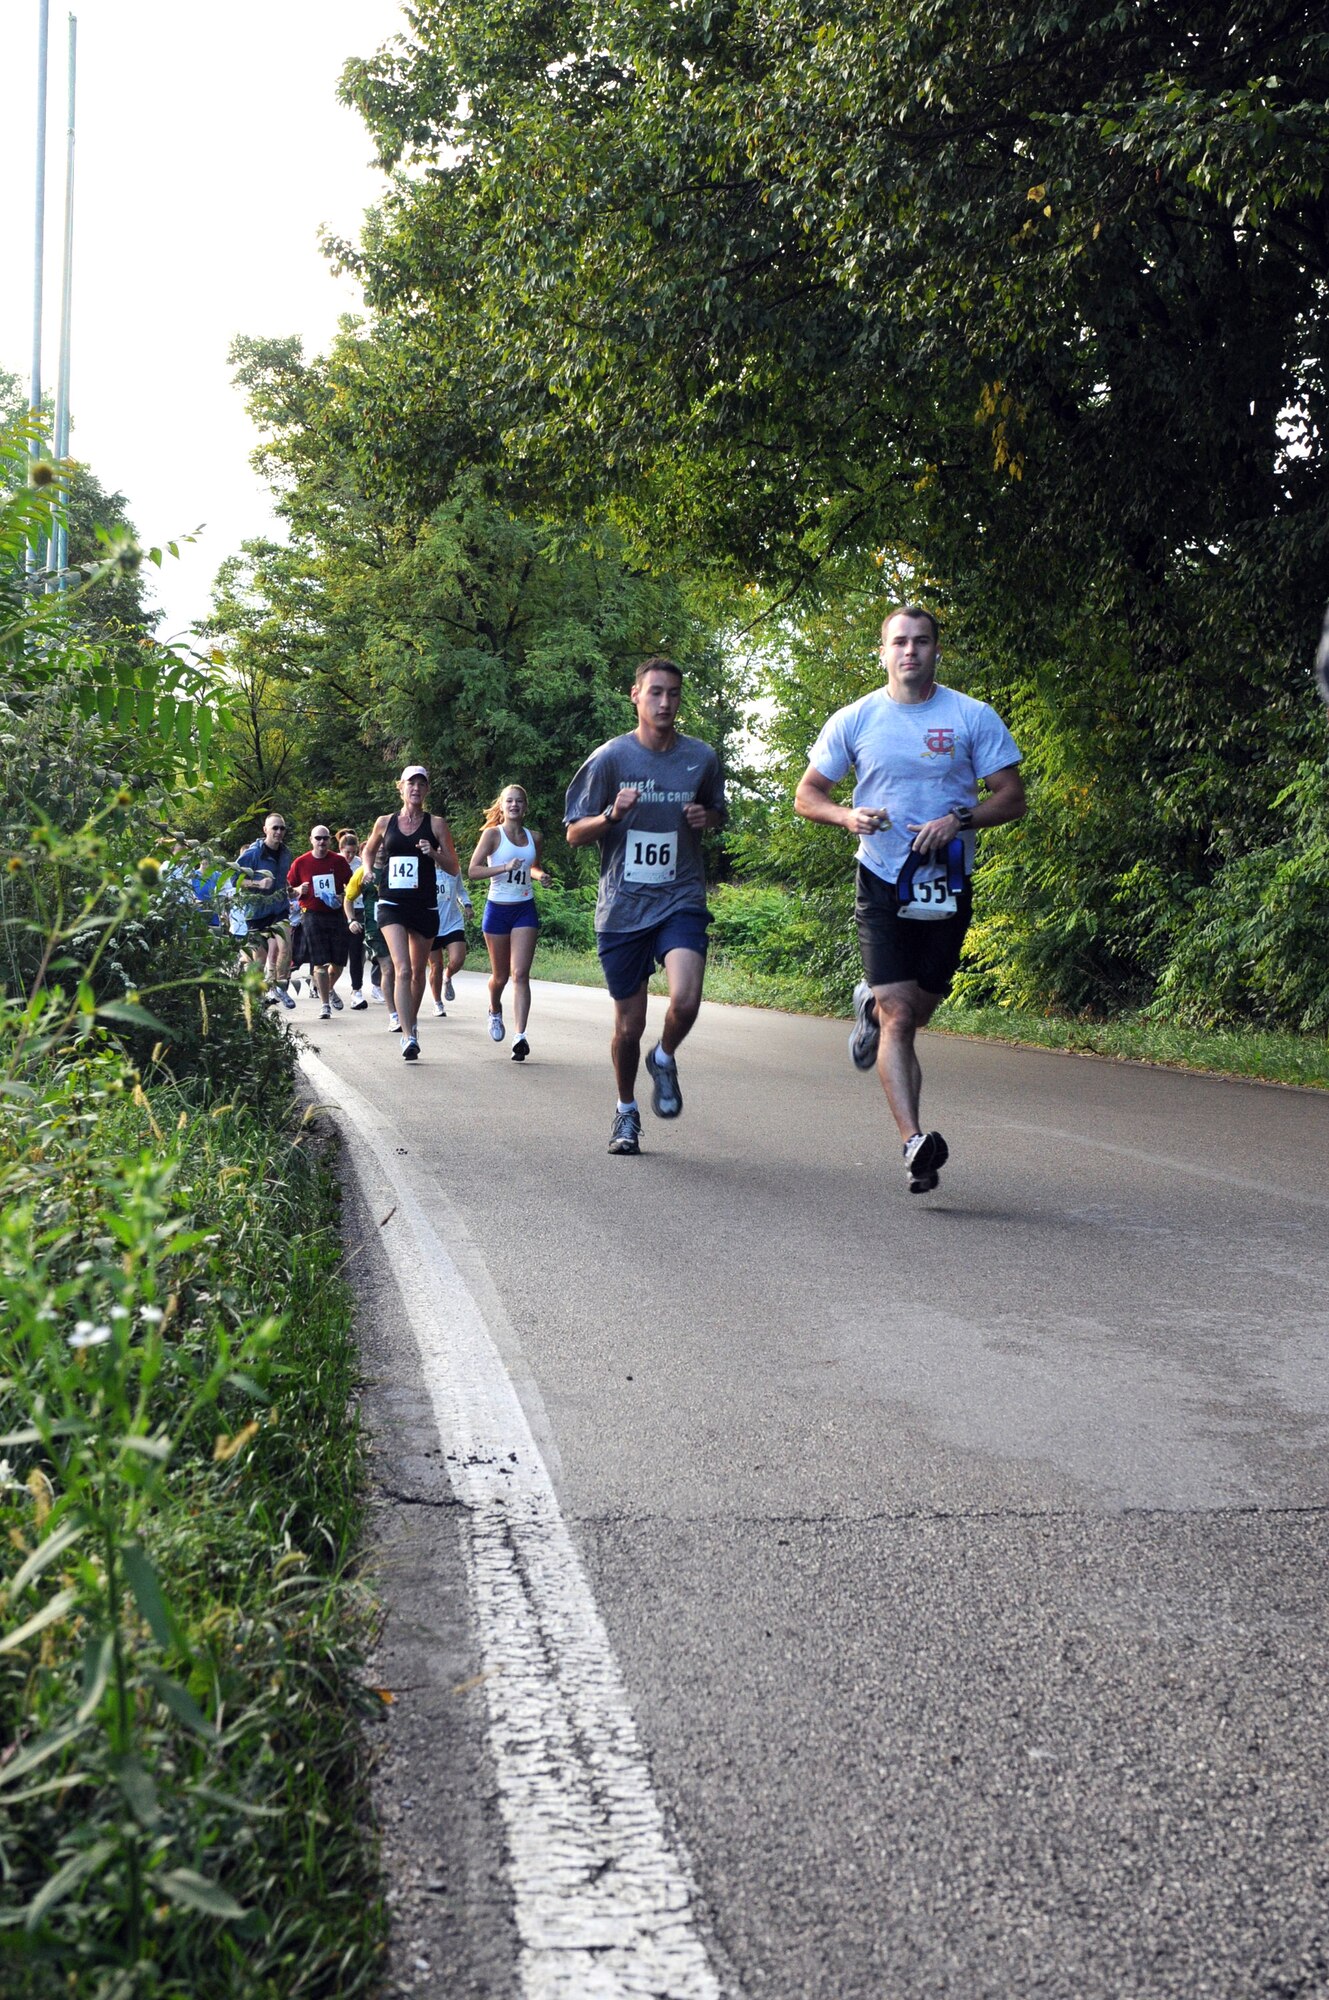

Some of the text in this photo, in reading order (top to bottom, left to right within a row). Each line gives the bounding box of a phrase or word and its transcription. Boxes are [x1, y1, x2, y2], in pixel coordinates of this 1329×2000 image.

[634, 842, 670, 865] 166
[393, 863, 414, 877] 142
[507, 868, 526, 885] 141
[319, 879, 330, 889] 64
[915, 872, 946, 904] 55
